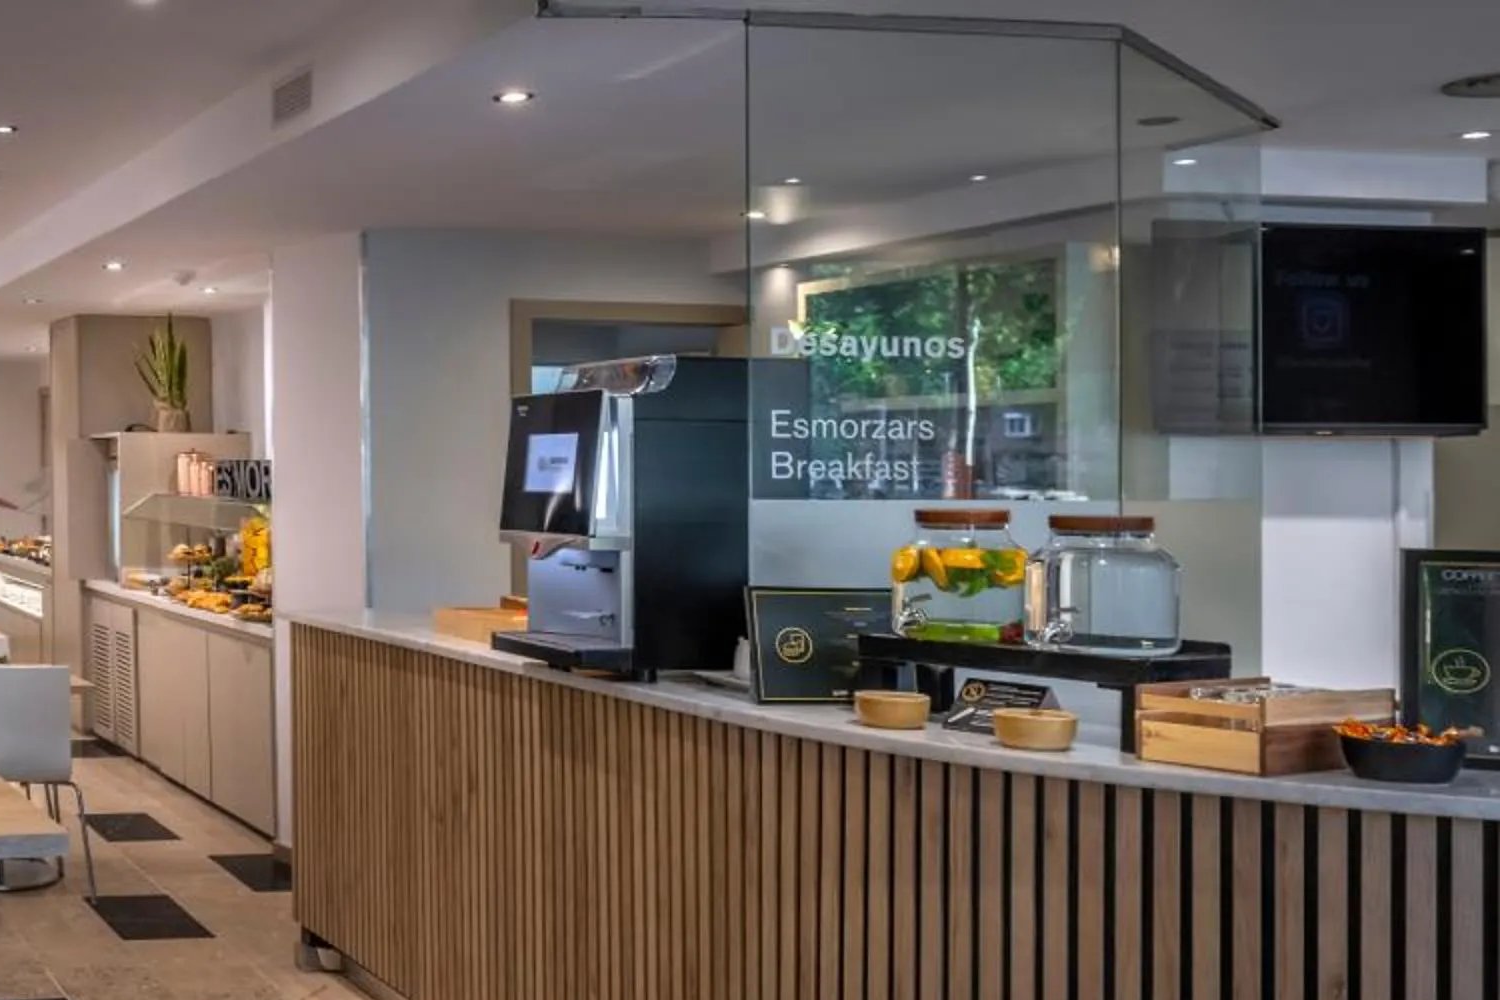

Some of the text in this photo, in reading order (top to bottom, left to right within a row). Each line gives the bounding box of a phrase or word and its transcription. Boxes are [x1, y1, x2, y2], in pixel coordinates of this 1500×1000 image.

[770, 327, 966, 363] Desayunos
[770, 409, 935, 440] Esmorzars
[770, 451, 920, 481] Breakfast
